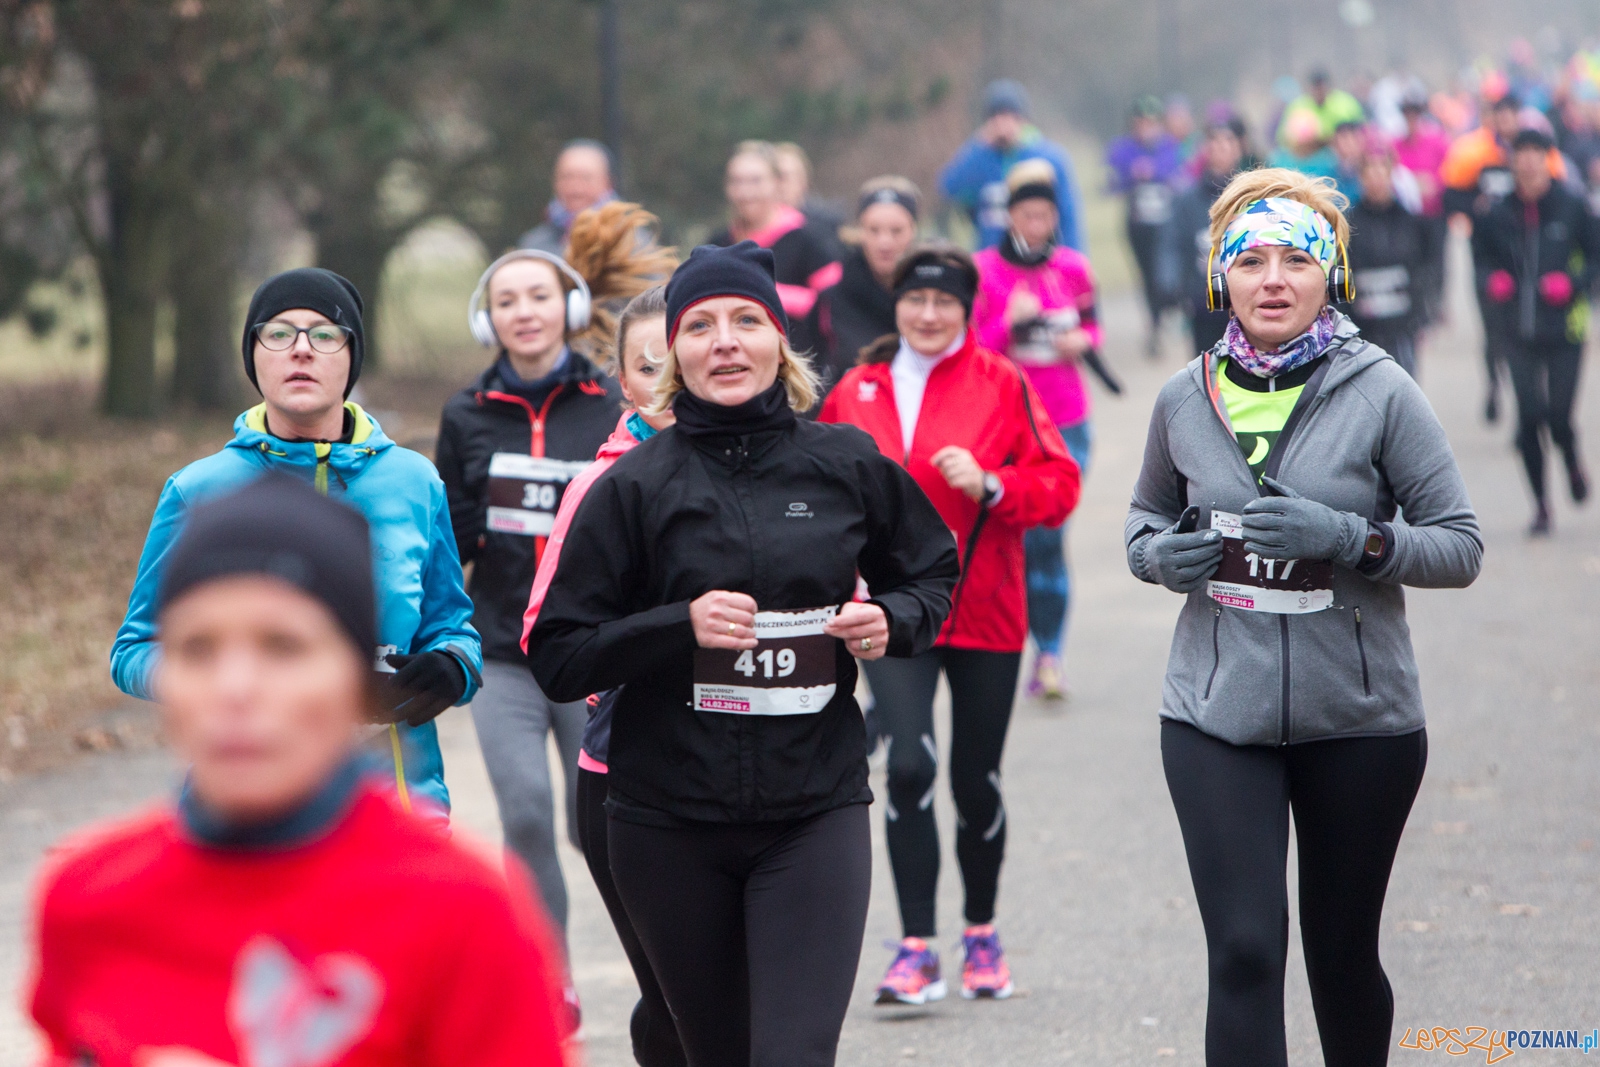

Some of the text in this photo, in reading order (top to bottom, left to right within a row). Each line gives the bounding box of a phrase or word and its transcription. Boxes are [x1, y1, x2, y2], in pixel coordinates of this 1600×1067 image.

[521, 483, 556, 509] 30
[1244, 552, 1299, 580] 117
[734, 648, 796, 678] 419
[702, 701, 741, 710] 14.02.2016
